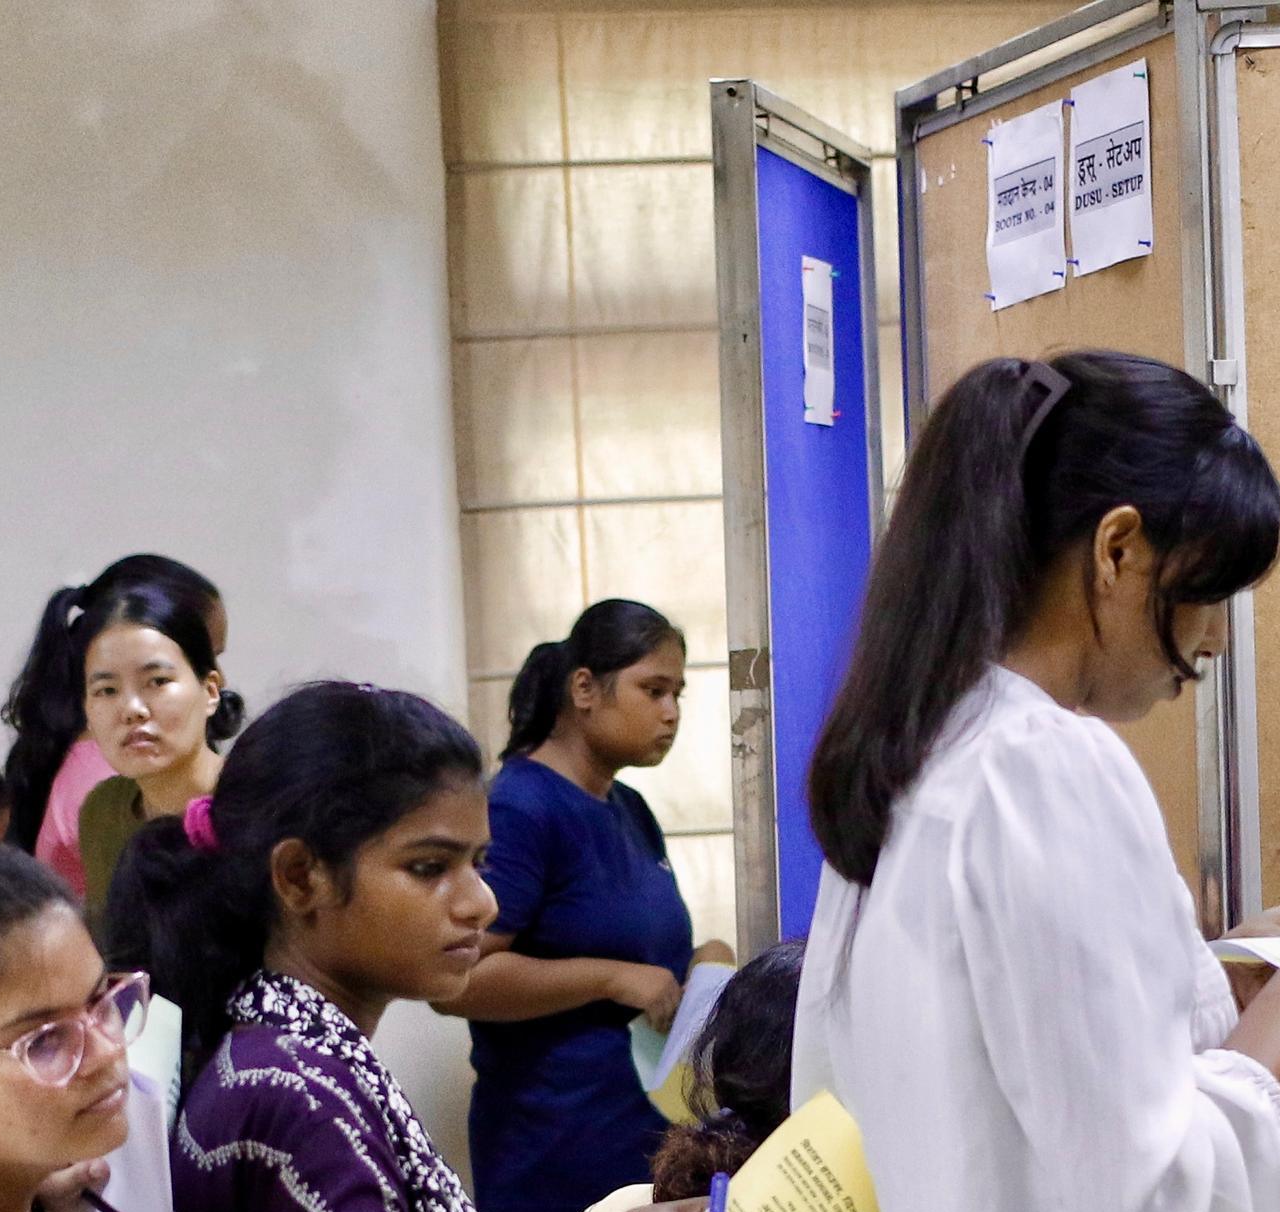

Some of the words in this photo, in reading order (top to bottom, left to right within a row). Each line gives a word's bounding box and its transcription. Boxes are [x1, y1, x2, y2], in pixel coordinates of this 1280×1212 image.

[1106, 137, 1142, 169] सेटअप
[1044, 174, 1053, 191] 04
[1075, 188, 1102, 211] DUSU
[1111, 174, 1144, 198] SETUP
[995, 212, 1022, 233] BOOTH
[1025, 208, 1036, 221] NO.
[1045, 201, 1055, 215] 04
